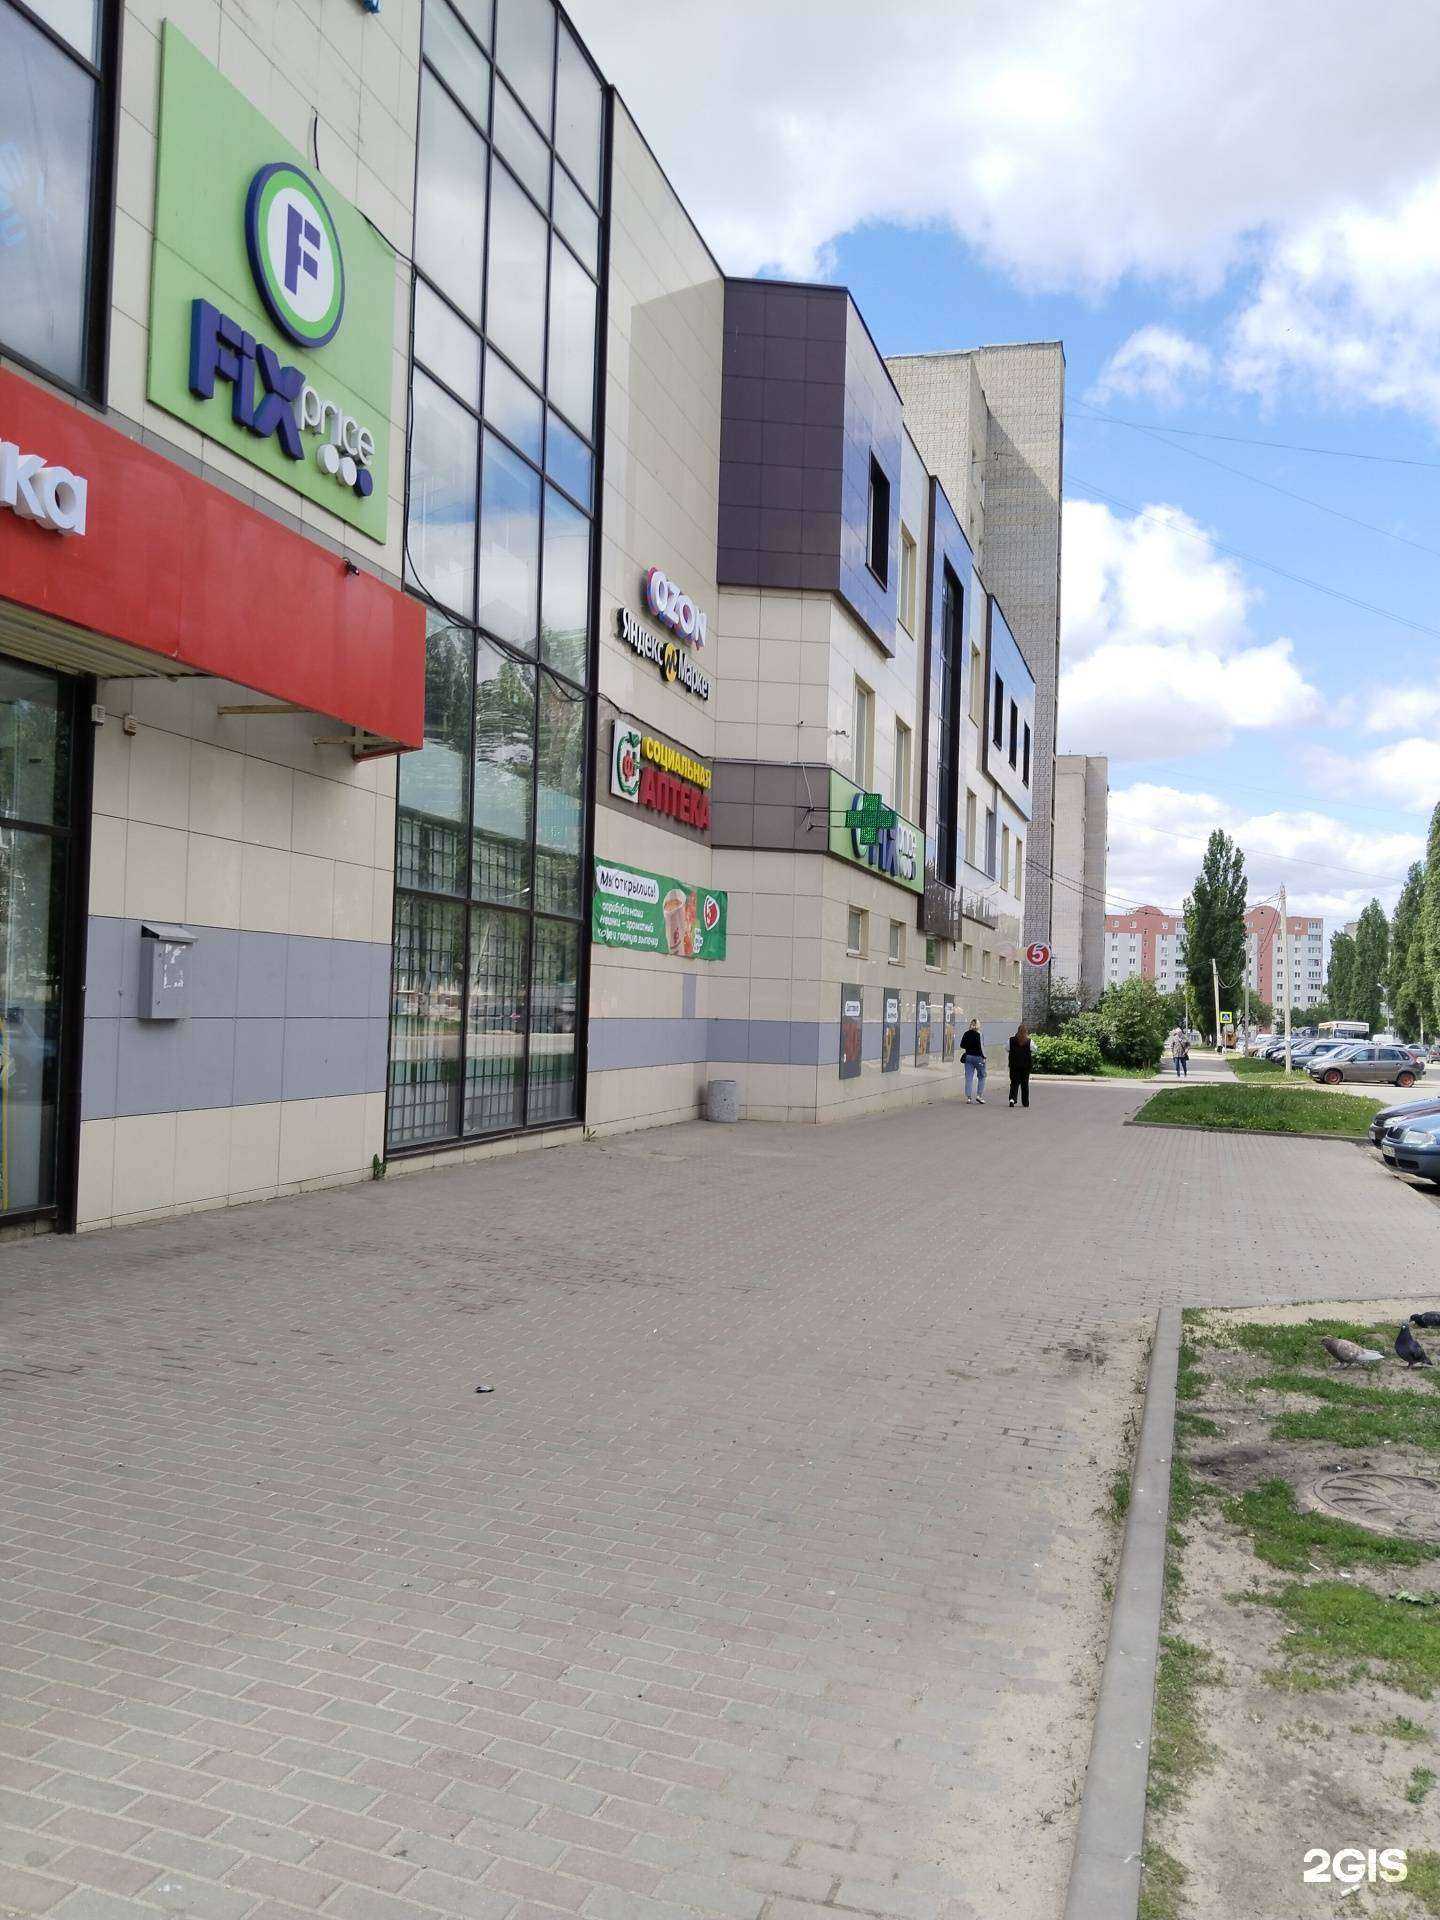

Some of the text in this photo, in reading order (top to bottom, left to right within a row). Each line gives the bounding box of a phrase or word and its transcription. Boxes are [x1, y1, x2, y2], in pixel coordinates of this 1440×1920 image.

[0, 438, 88, 536] ка
[619, 607, 712, 700] Яндекс Маркет
[642, 735, 712, 790] СОЦИАЛЬНАЯ
[640, 766, 711, 830] АПТЕКА
[599, 870, 657, 898] Мы открылись!
